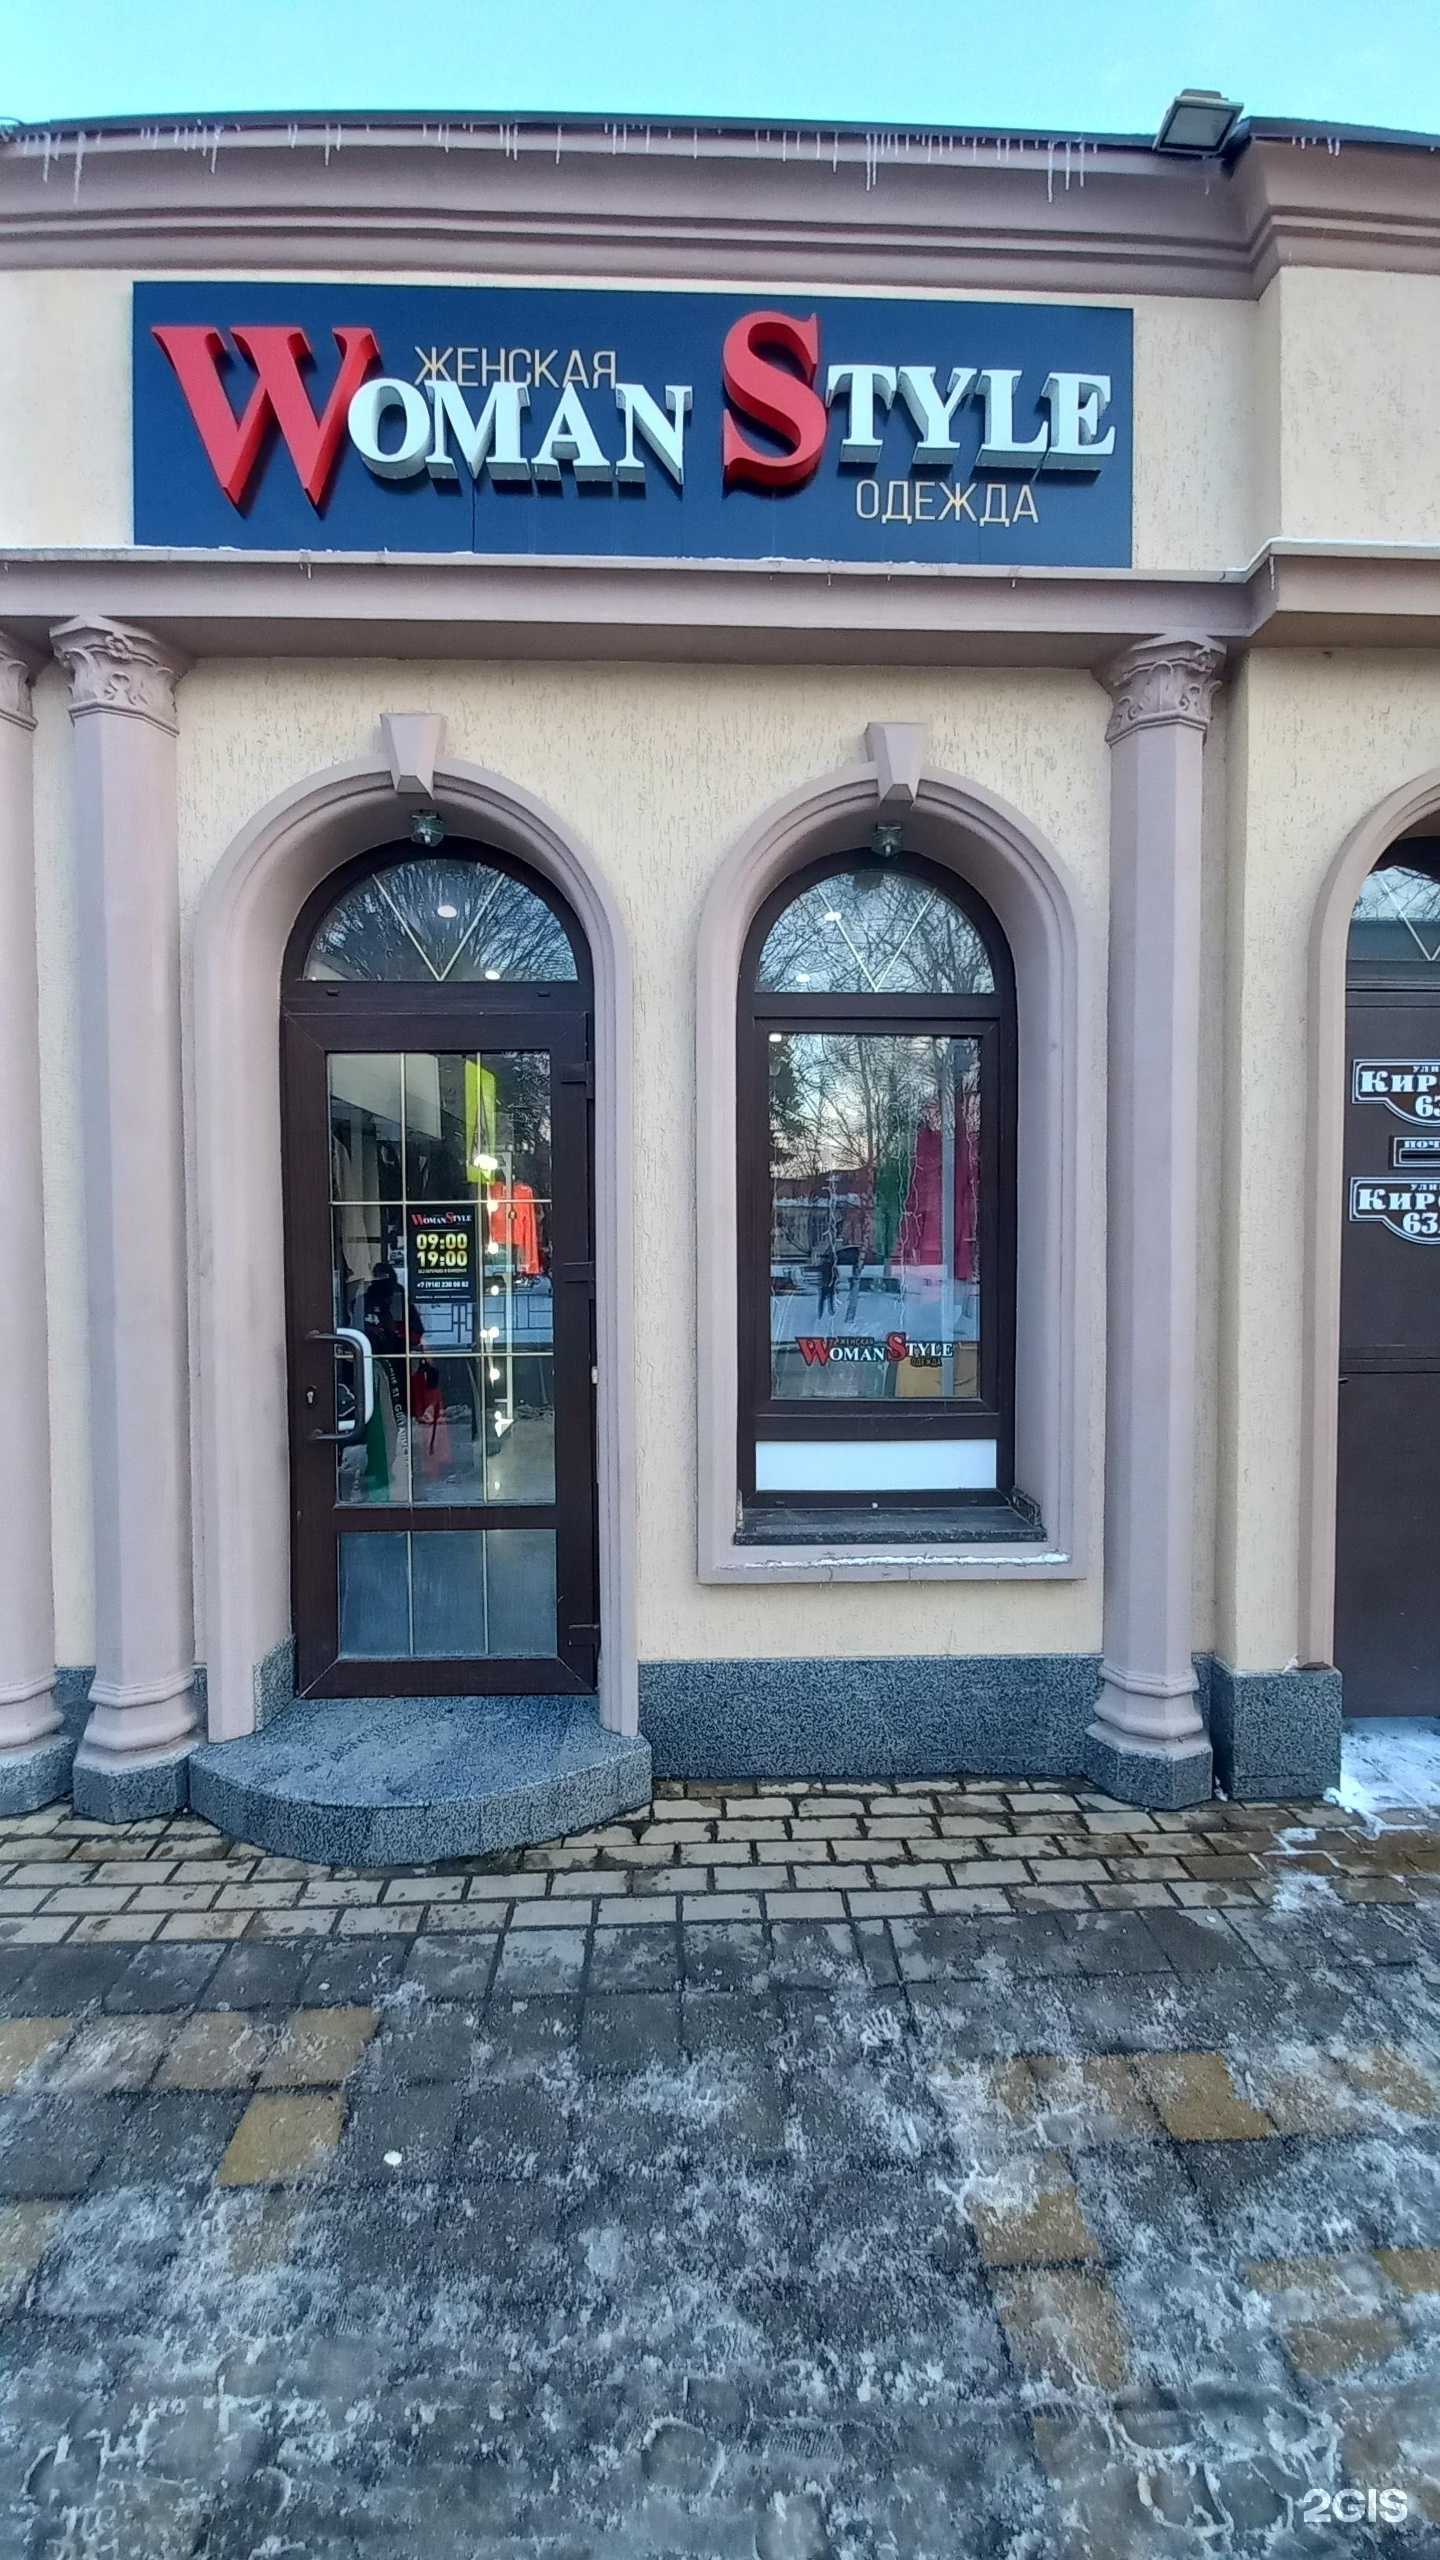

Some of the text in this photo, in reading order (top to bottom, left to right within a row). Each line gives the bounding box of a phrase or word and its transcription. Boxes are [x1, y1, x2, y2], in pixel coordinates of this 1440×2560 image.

[414, 345, 617, 390] ЖЕНСКАЯ
[151, 311, 1117, 506] WOMAN STYLE
[855, 479, 1039, 528] ОДЕЖДА
[416, 1233, 468, 1250] 09:00
[416, 1250, 468, 1267] 19:00
[797, 1332, 953, 1366] WOMAN STYLE
